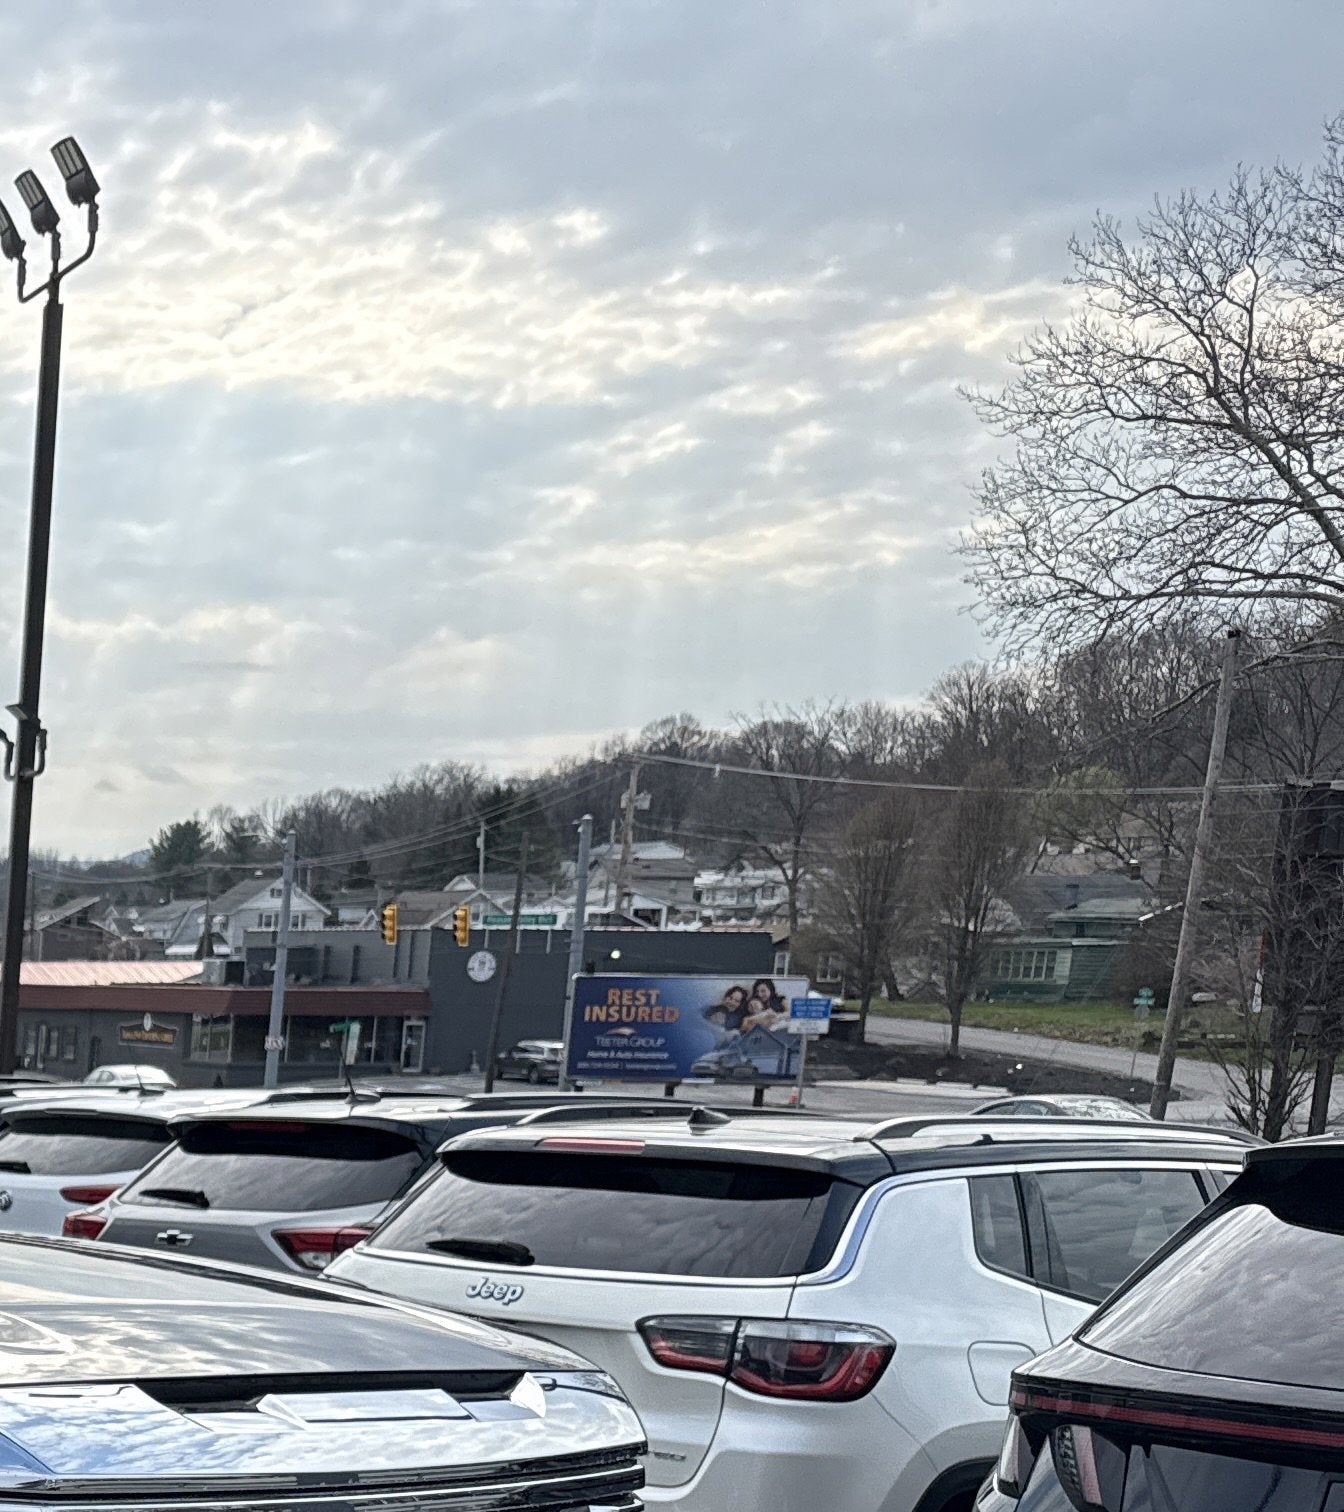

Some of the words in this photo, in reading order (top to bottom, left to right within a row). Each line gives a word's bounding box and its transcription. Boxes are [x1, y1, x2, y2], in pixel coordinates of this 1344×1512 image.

[608, 988, 660, 1005] REST
[584, 1005, 680, 1023] INSURED
[466, 1276, 524, 1306] Jeep
